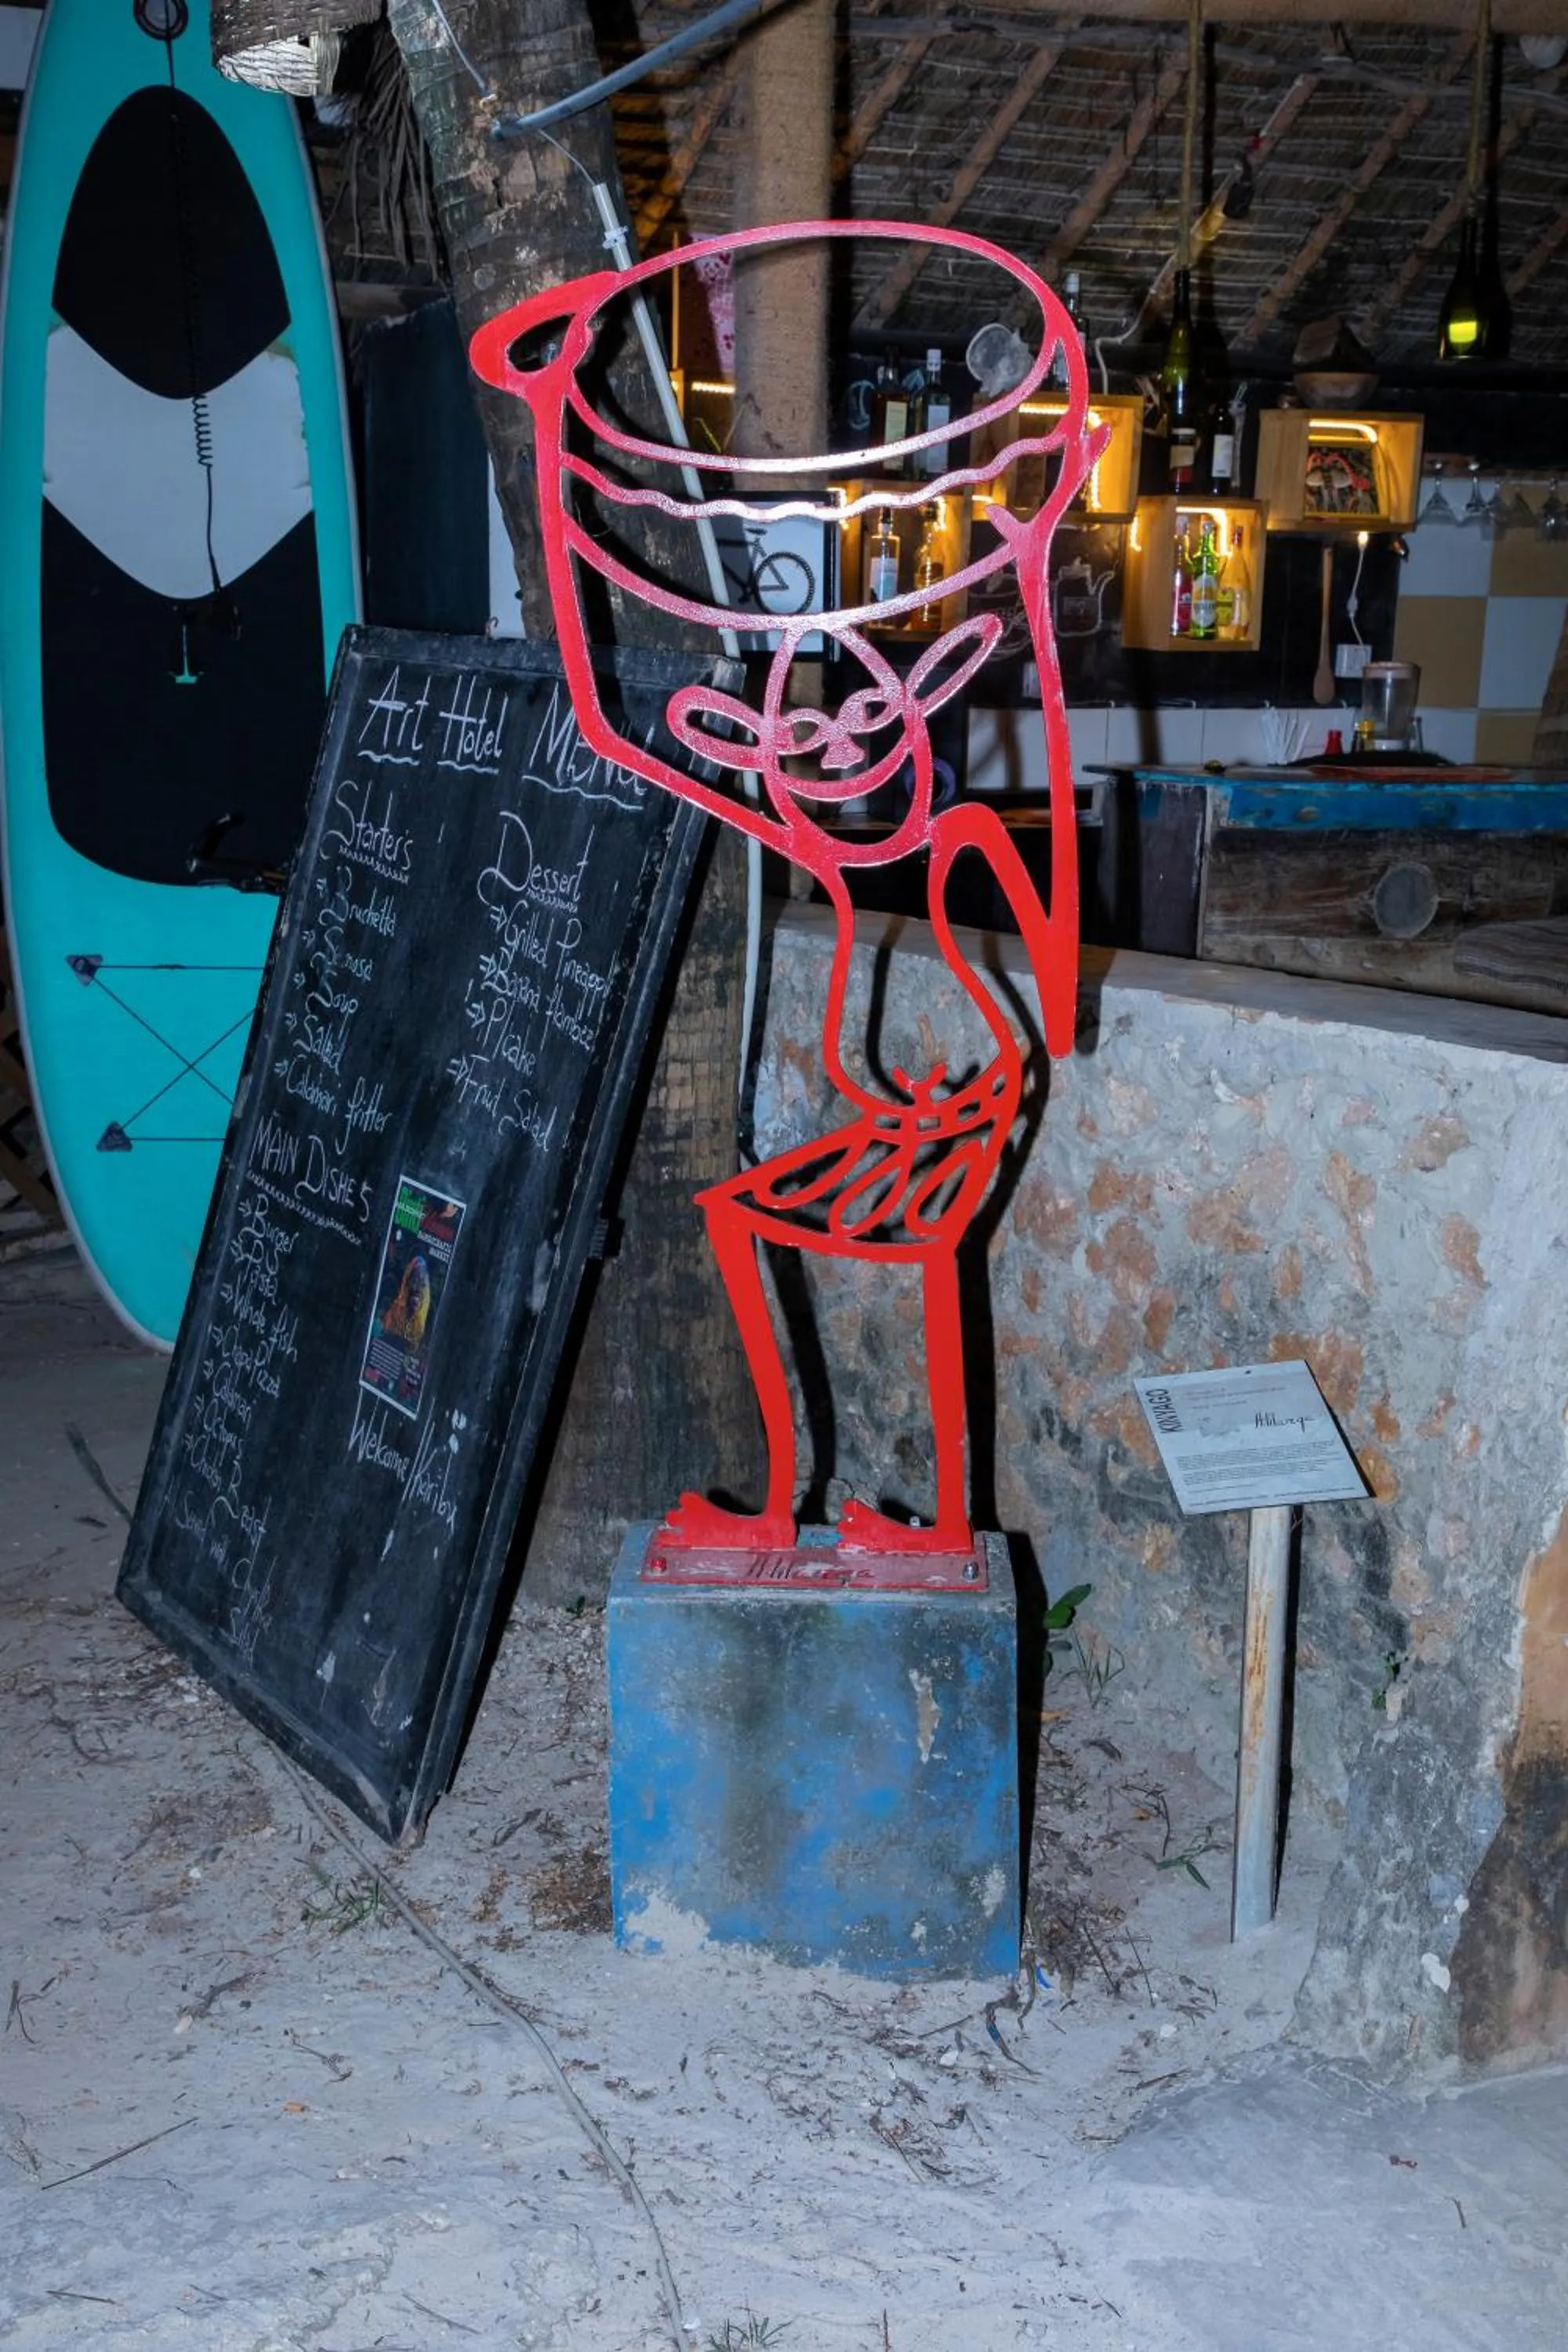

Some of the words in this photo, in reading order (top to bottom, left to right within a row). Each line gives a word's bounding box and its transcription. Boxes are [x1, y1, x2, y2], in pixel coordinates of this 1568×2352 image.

[358, 665, 430, 751] Art
[439, 675, 508, 761] Hotel
[320, 779, 413, 869] Starter's
[477, 811, 594, 906] Dessert
[505, 900, 554, 968] Grilled
[305, 970, 358, 1041] Soup
[481, 947, 540, 1014] Banana
[293, 1014, 350, 1076] Salad
[287, 1054, 341, 1116] Calamari
[499, 1089, 557, 1151] Salad
[249, 1115, 299, 1175] MAIN
[294, 1135, 372, 1223] DISHES
[238, 1193, 299, 1275] Burger
[238, 1240, 278, 1305] Pasta
[267, 1305, 298, 1366] fish
[1145, 1388, 1184, 1434] KINYAGO
